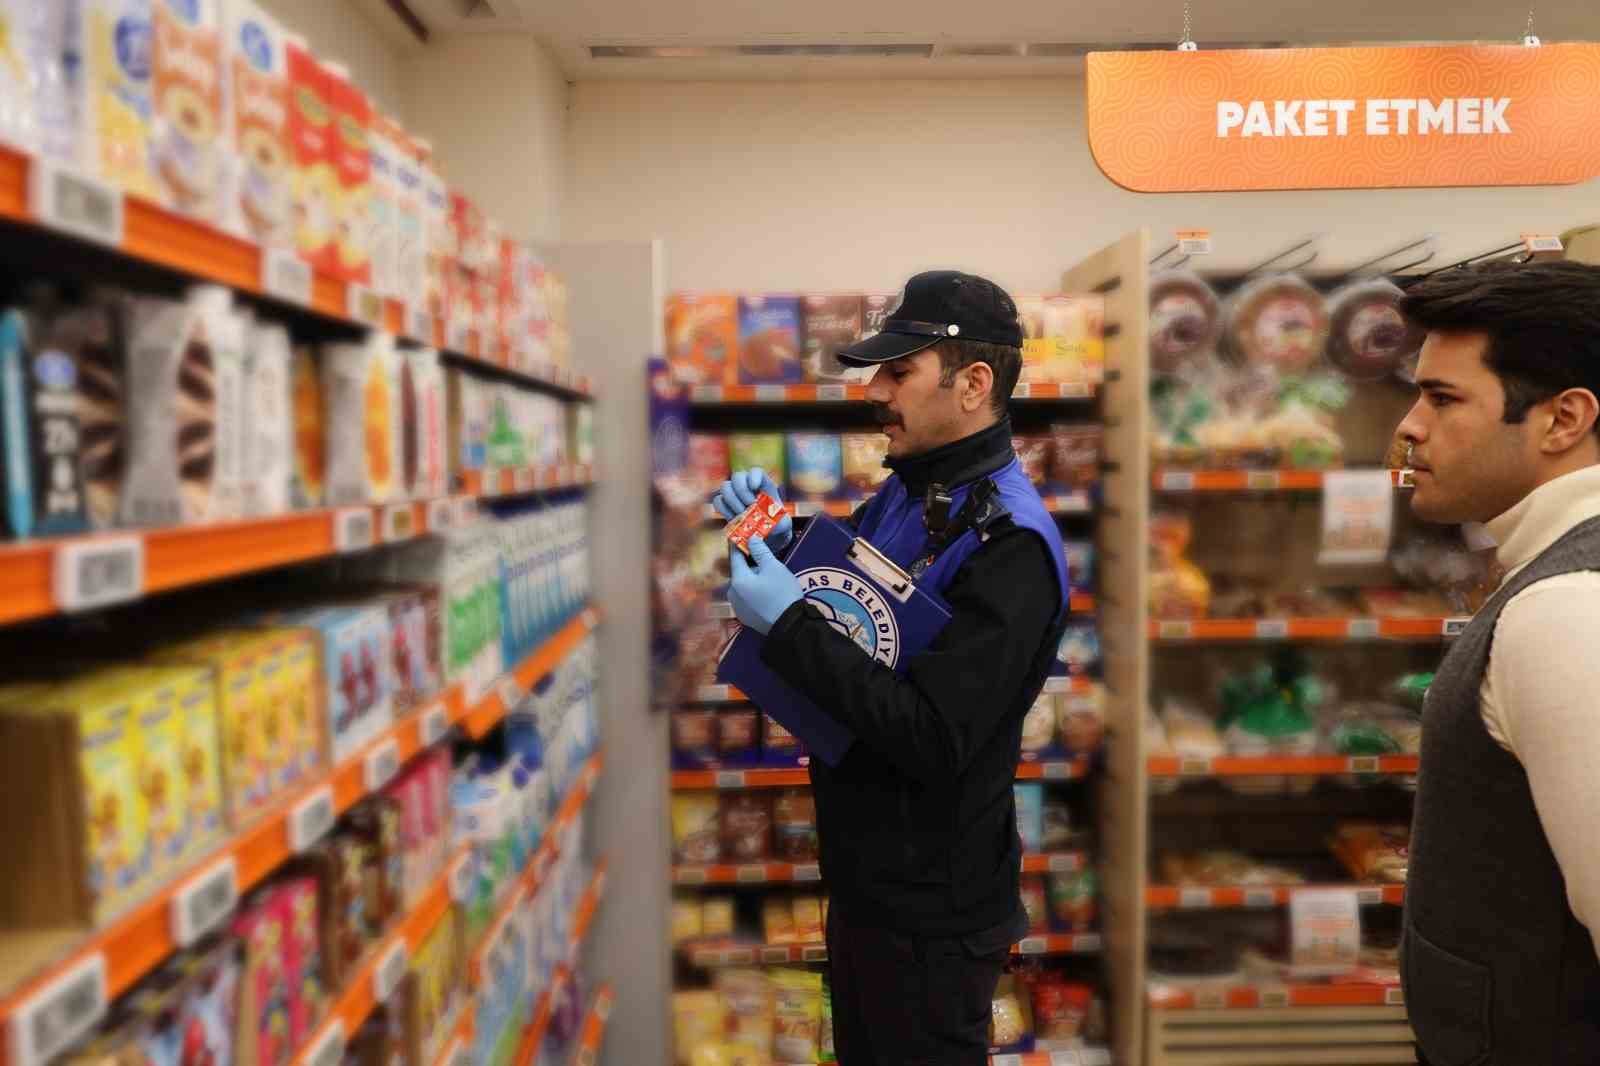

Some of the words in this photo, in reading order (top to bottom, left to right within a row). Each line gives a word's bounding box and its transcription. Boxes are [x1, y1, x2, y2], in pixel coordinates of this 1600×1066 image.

[1216, 99, 1355, 137] PAKET
[1366, 97, 1512, 136] ETMEK
[842, 579, 894, 665] BELEDİY
